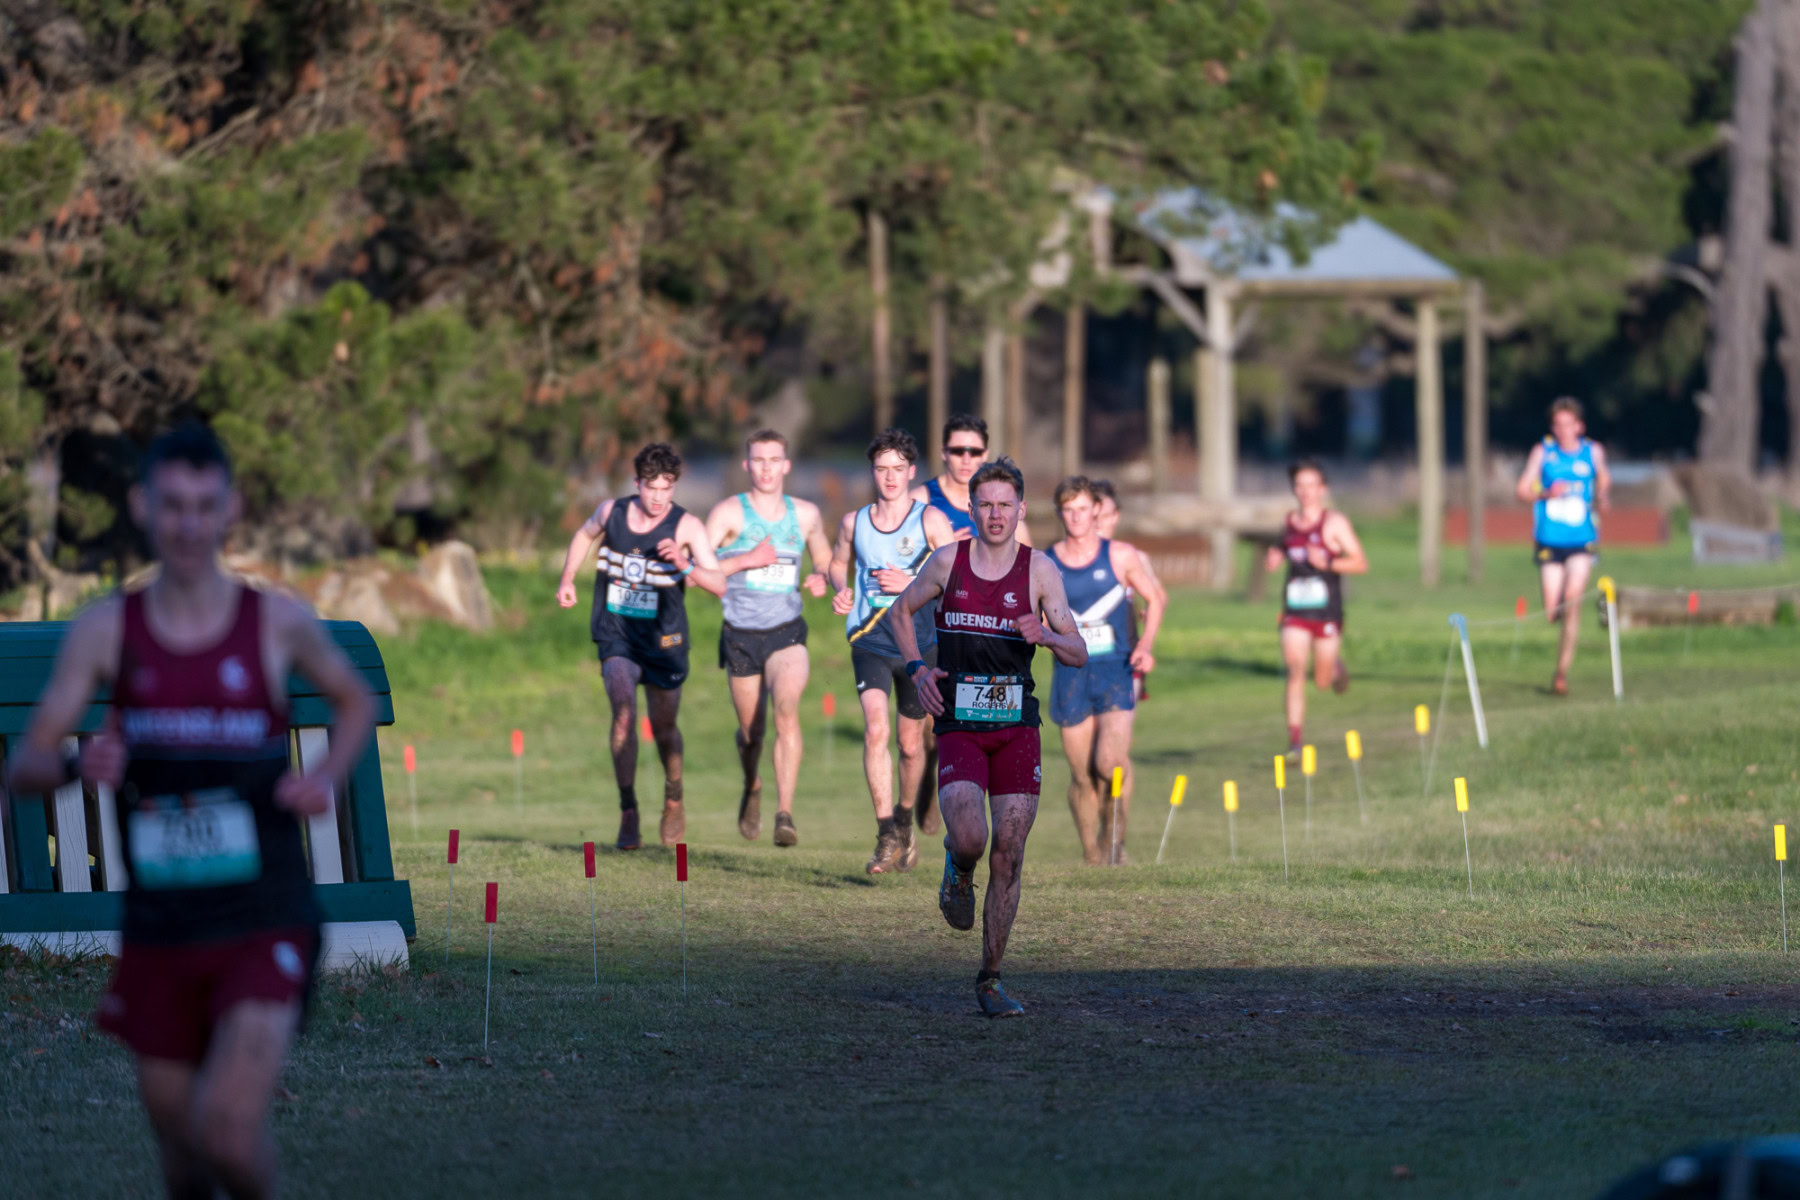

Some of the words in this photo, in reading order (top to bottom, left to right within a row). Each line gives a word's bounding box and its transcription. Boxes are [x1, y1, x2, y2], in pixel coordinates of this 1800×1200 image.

[762, 565, 784, 578] 939
[617, 588, 648, 604] 1074
[974, 686, 1006, 702] 748
[972, 701, 1007, 710] ROGERS
